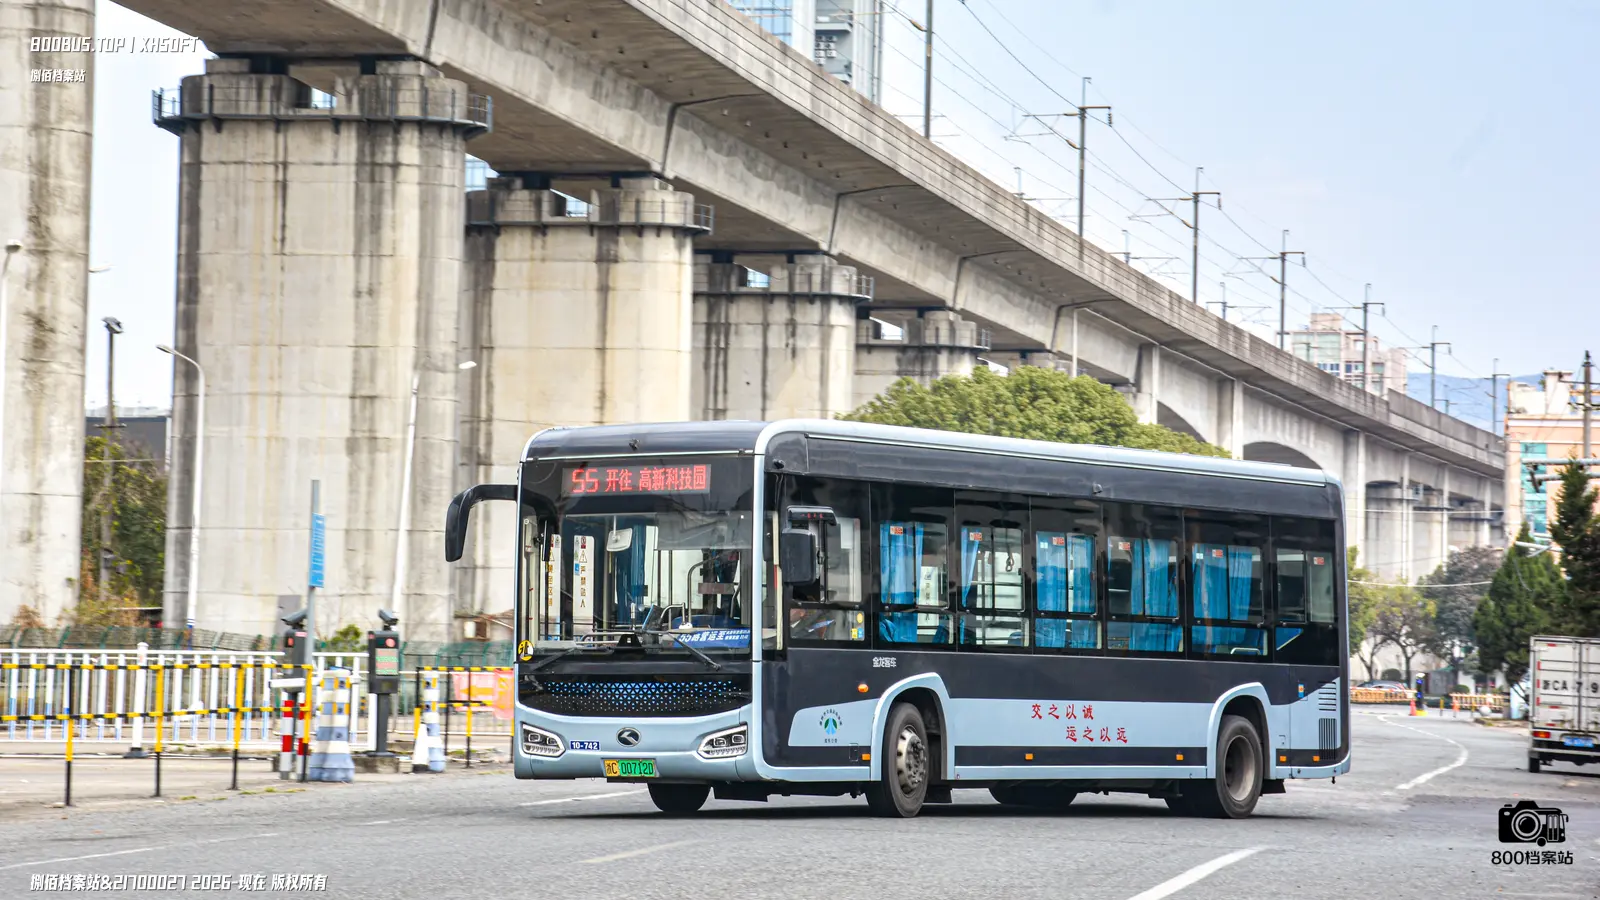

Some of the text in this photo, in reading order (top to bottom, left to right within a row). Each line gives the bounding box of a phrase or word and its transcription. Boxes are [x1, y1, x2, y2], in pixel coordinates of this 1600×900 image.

[571, 464, 708, 494] 55 开往 高新科技园
[872, 656, 897, 668] 金龙客车
[1030, 703, 1094, 720] 交之以诚
[1065, 726, 1128, 744] 运之以远
[571, 741, 598, 750] 10-742
